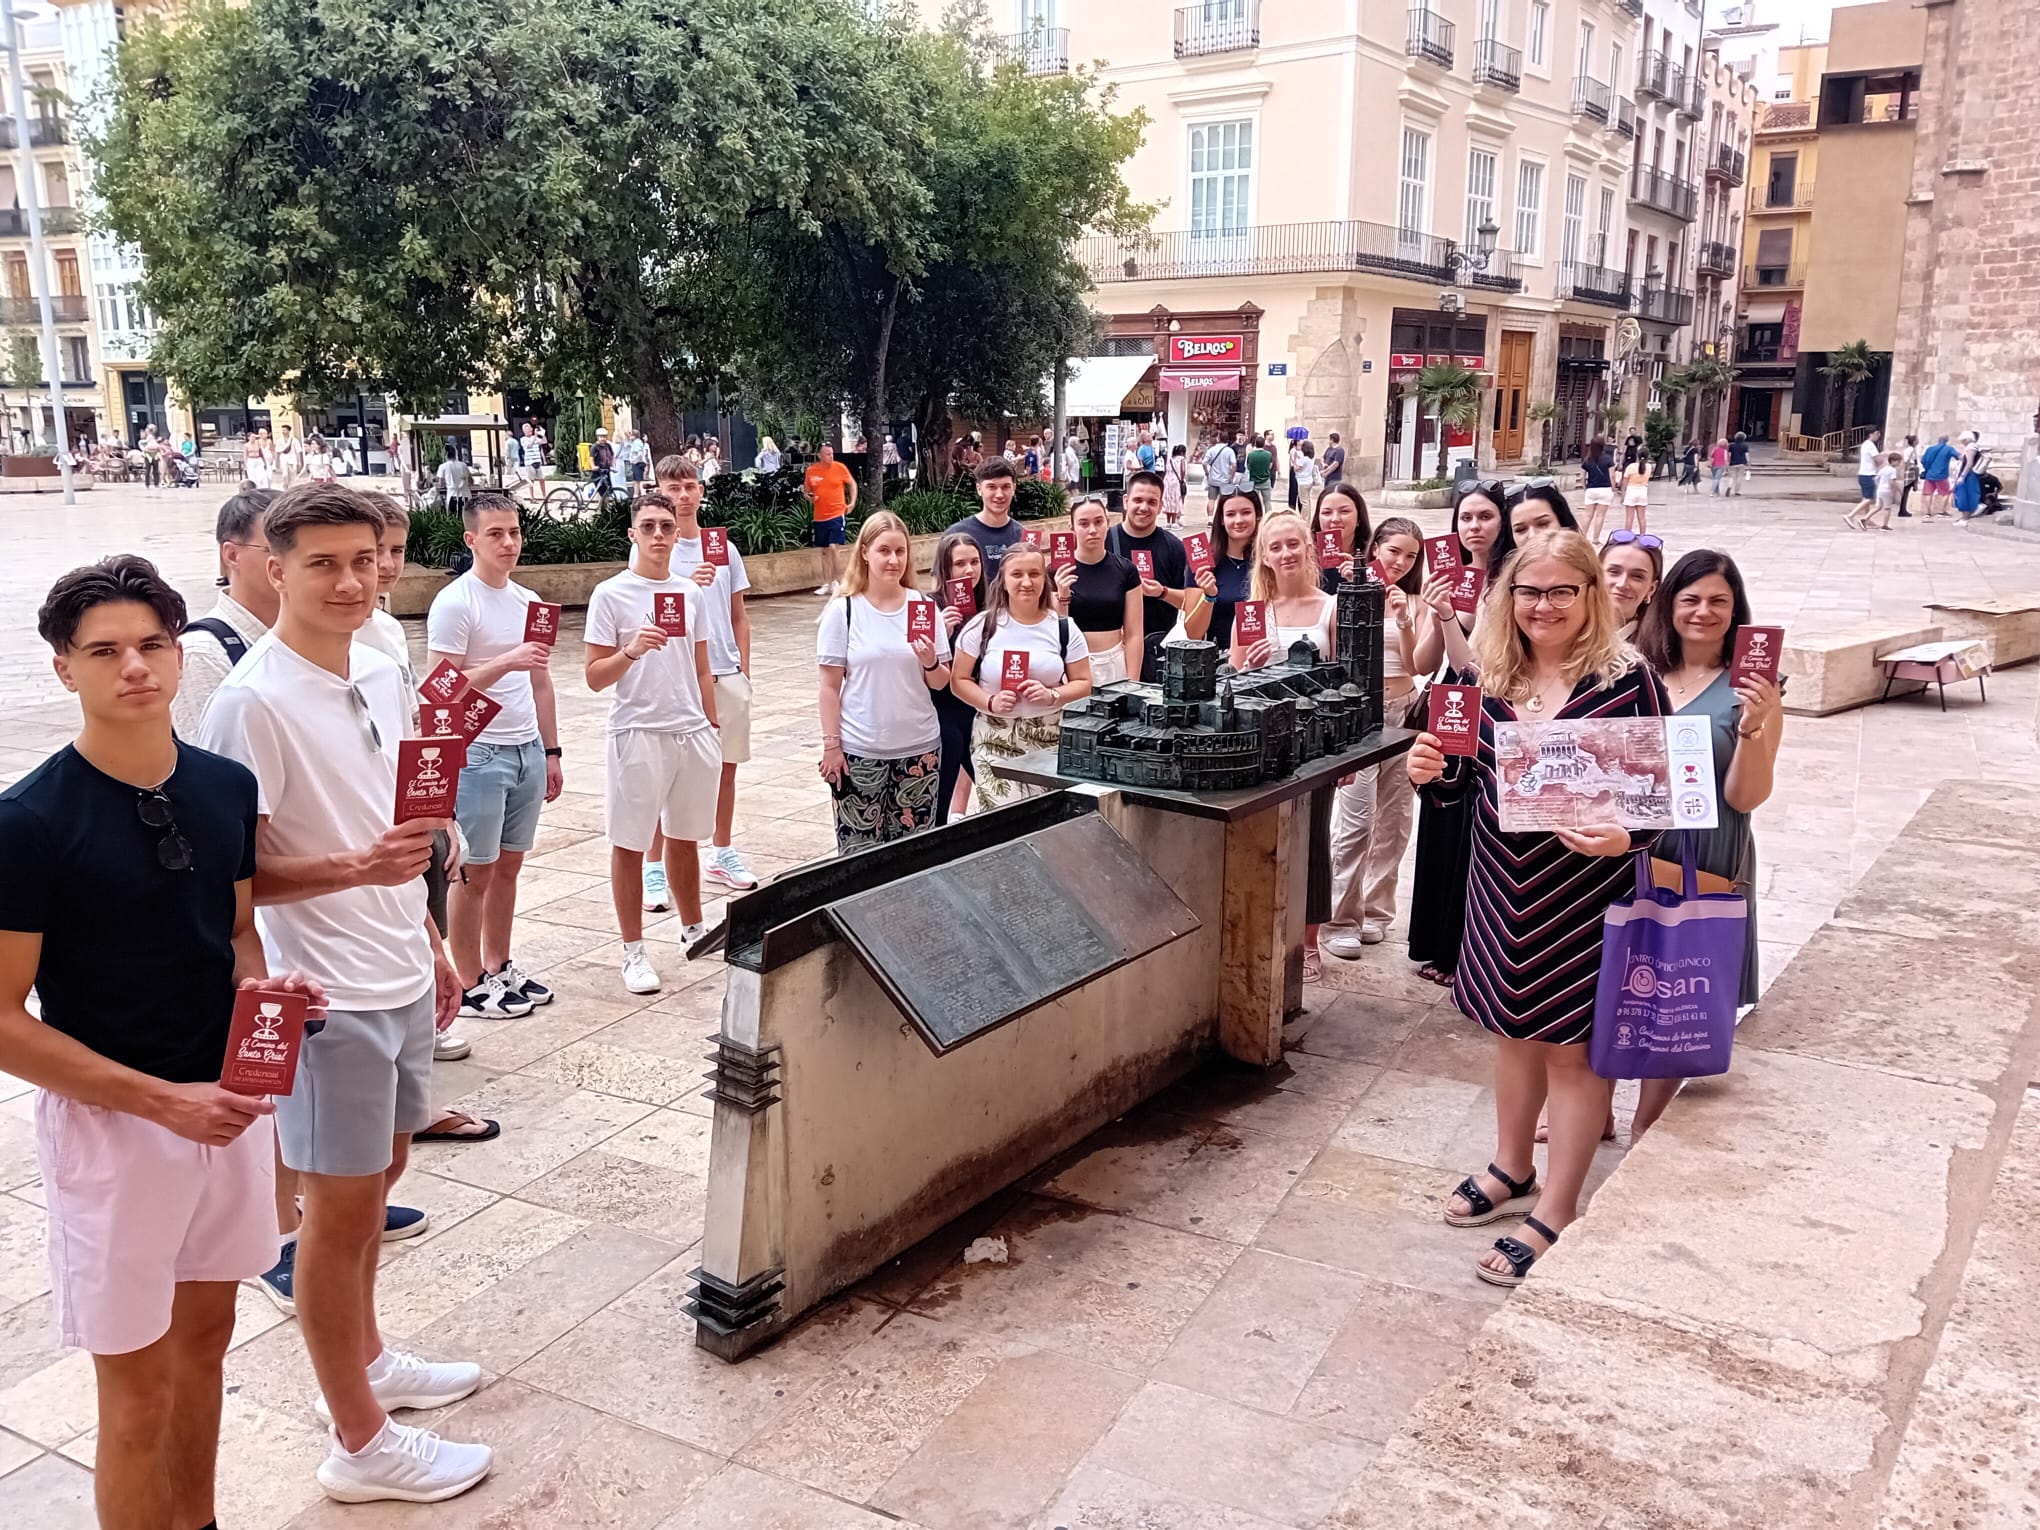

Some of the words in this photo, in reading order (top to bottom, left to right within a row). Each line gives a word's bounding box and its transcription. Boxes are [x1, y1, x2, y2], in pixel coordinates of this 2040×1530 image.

[1178, 340, 1226, 358] BELROS
[1180, 376, 1213, 389] BELROS
[241, 1038, 251, 1047] El
[251, 1039, 276, 1049] Camino
[276, 1042, 290, 1050] del
[237, 1046, 262, 1058] Santo
[263, 1049, 288, 1064] Grial
